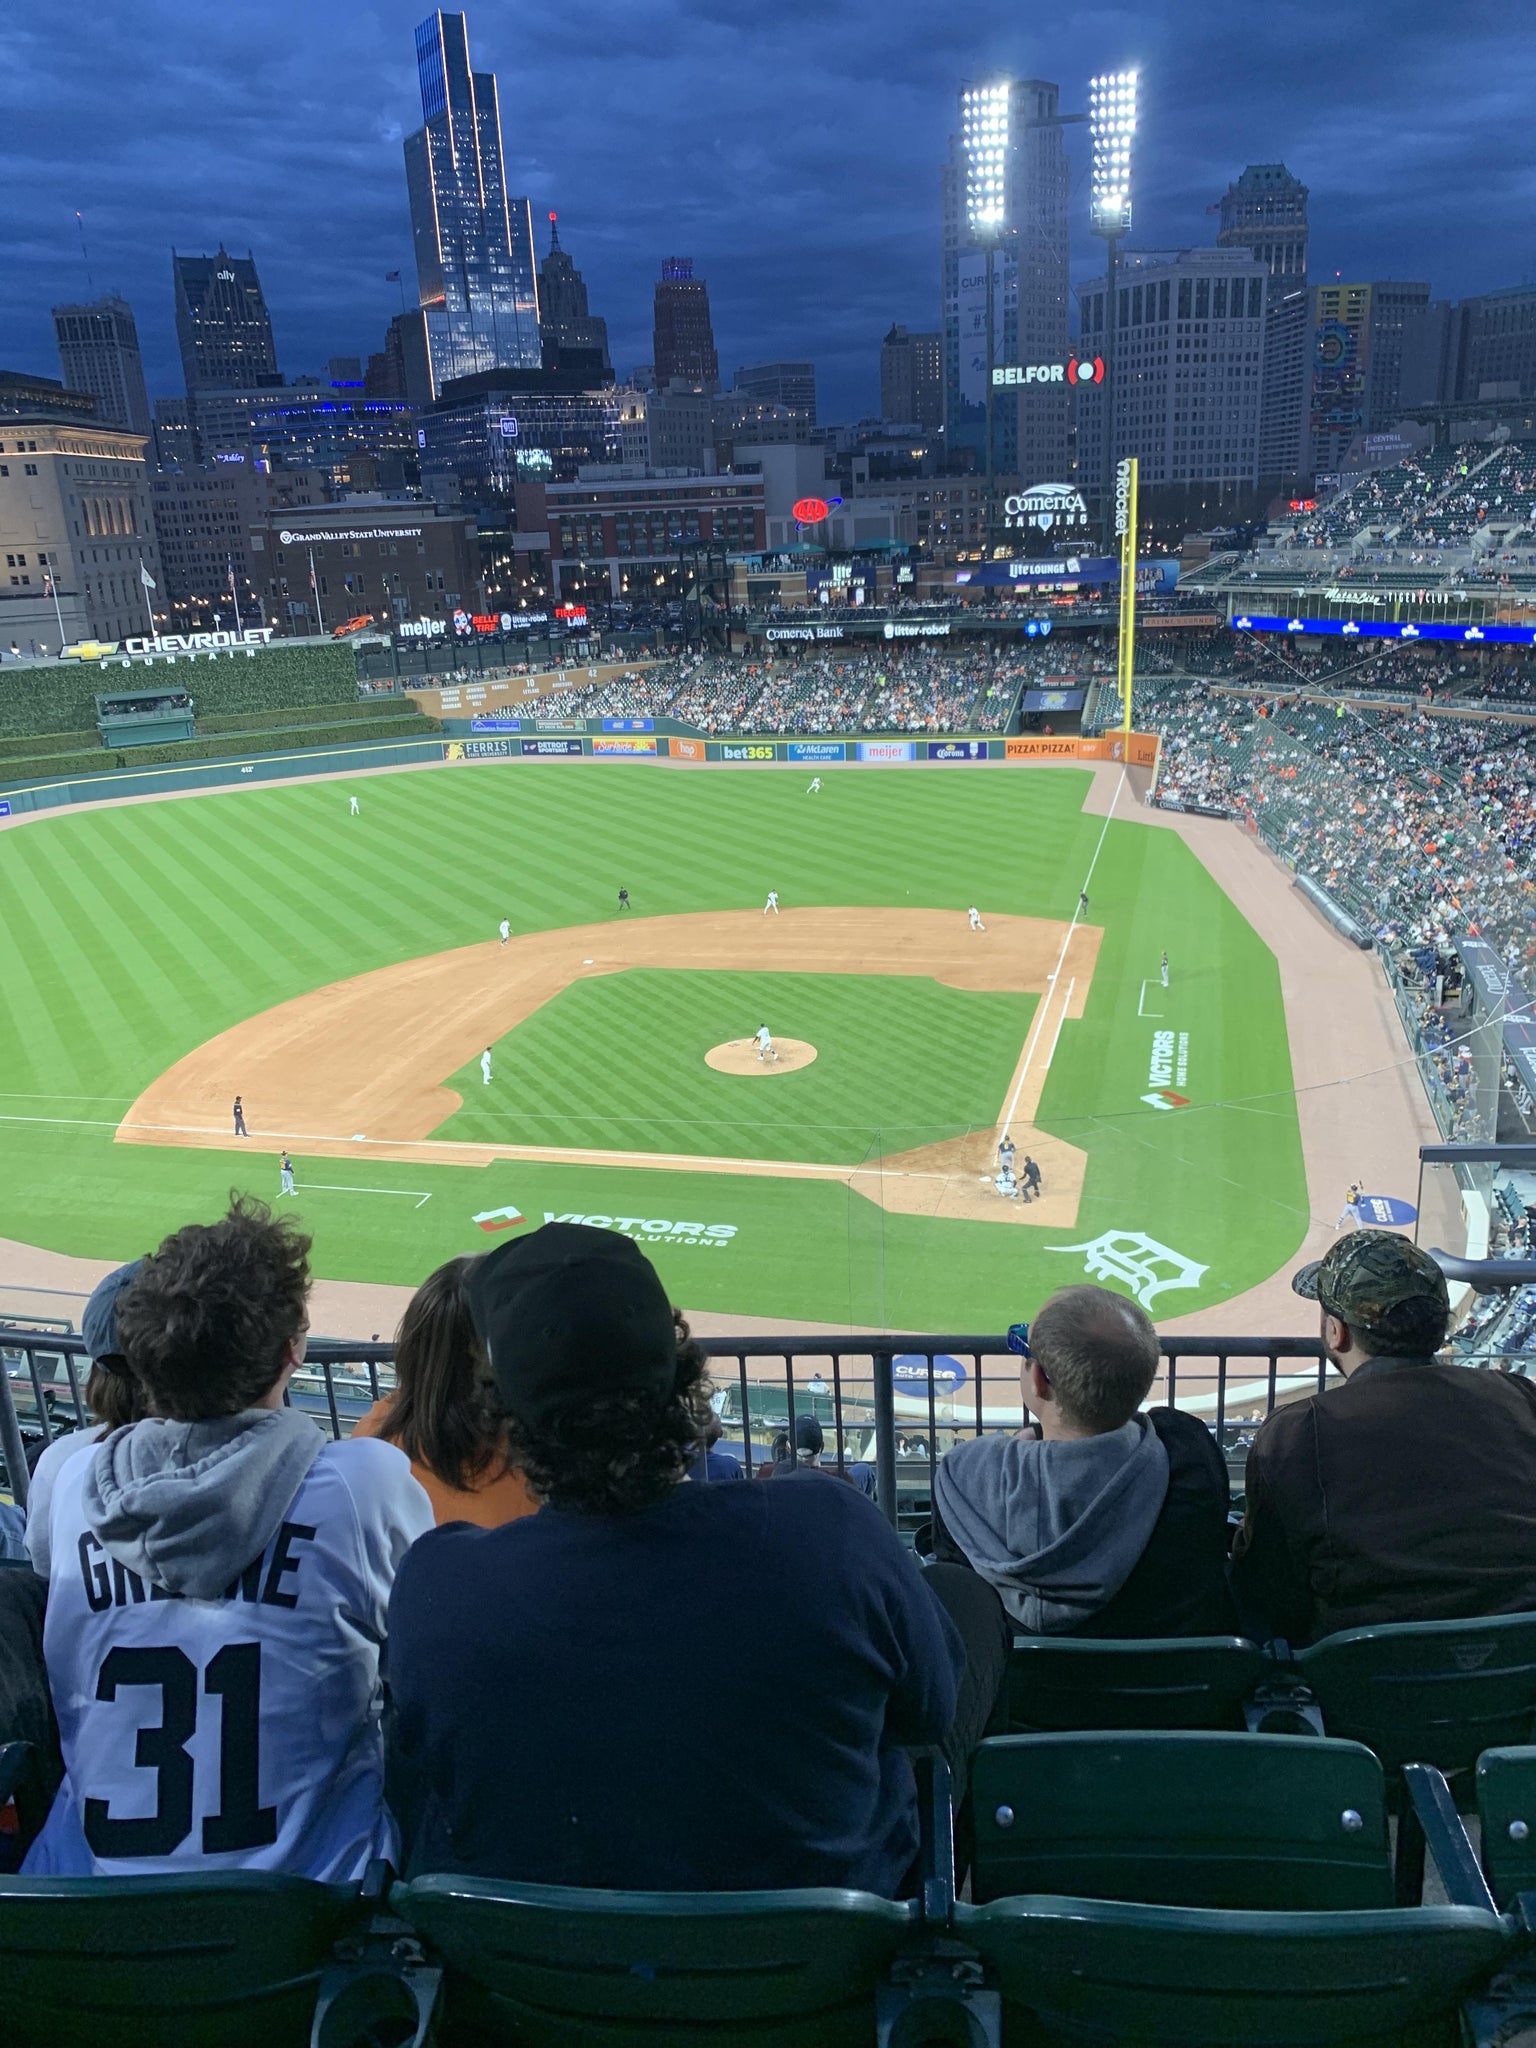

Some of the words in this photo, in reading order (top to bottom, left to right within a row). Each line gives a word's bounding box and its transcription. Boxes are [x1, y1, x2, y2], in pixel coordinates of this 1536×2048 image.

[217, 270, 235, 282] ally
[992, 365, 1064, 385] BELFOR
[1373, 433, 1401, 442] CENTRAL
[223, 453, 245, 463] Ashley
[1115, 477, 1130, 536] Rocket
[1004, 513, 1088, 530] LANDING
[292, 533, 321, 542] GRAND
[321, 531, 350, 541] VALLEY
[350, 530, 373, 539] STATE
[373, 528, 422, 537] UNIVERSITY
[1009, 563, 1030, 578] Lite
[1030, 563, 1065, 574] LOUNGE
[852, 577, 866, 586] PUB
[1388, 592, 1417, 603] TIGER
[1425, 593, 1449, 604] CLUB
[555, 605, 587, 619] FIEGER
[472, 614, 499, 625] BELLE
[567, 617, 587, 627] LAW
[400, 617, 447, 638] meijer
[476, 623, 497, 632] TIRE
[816, 627, 844, 638] Bank
[125, 628, 274, 655] CHEVROLET
[100, 649, 255, 670] FOUNTAIN
[558, 672, 566, 682] 11
[588, 669, 598, 678] 42
[526, 679, 535, 688] 10
[466, 741, 508, 753] FERRIS
[537, 741, 568, 749] DETROIT
[806, 744, 840, 754] McLaren
[1007, 743, 1040, 753] PIZZA!
[1042, 743, 1075, 753] PIZZA!
[724, 746, 773, 759] bet365
[869, 745, 903, 759] meijer
[937, 748, 964, 759] Corona
[1149, 1030, 1175, 1088] VICTORS
[84, 1642, 278, 1859] 31
